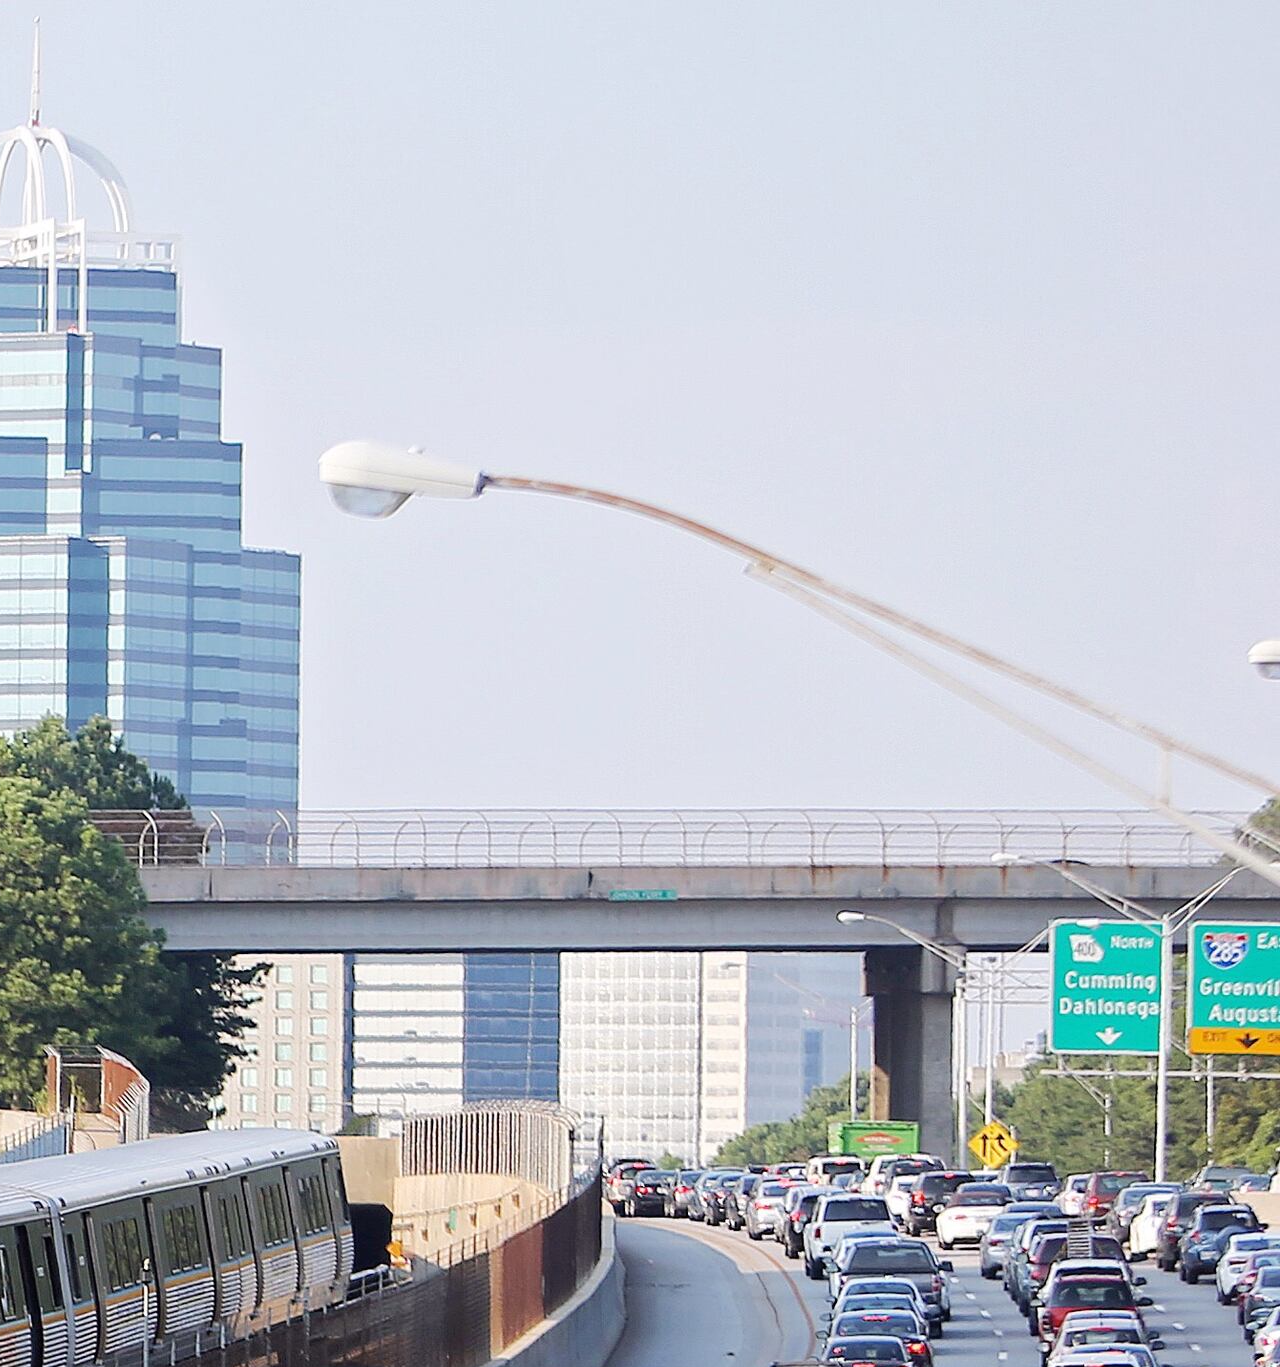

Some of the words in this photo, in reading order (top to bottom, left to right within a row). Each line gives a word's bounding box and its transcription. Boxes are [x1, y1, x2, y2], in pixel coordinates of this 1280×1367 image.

[1074, 942, 1096, 957] 400
[1110, 935, 1154, 949] NORTH
[1209, 943, 1243, 963] 285
[1064, 971, 1157, 994] Cumming
[1059, 997, 1160, 1019] Dahlonega
